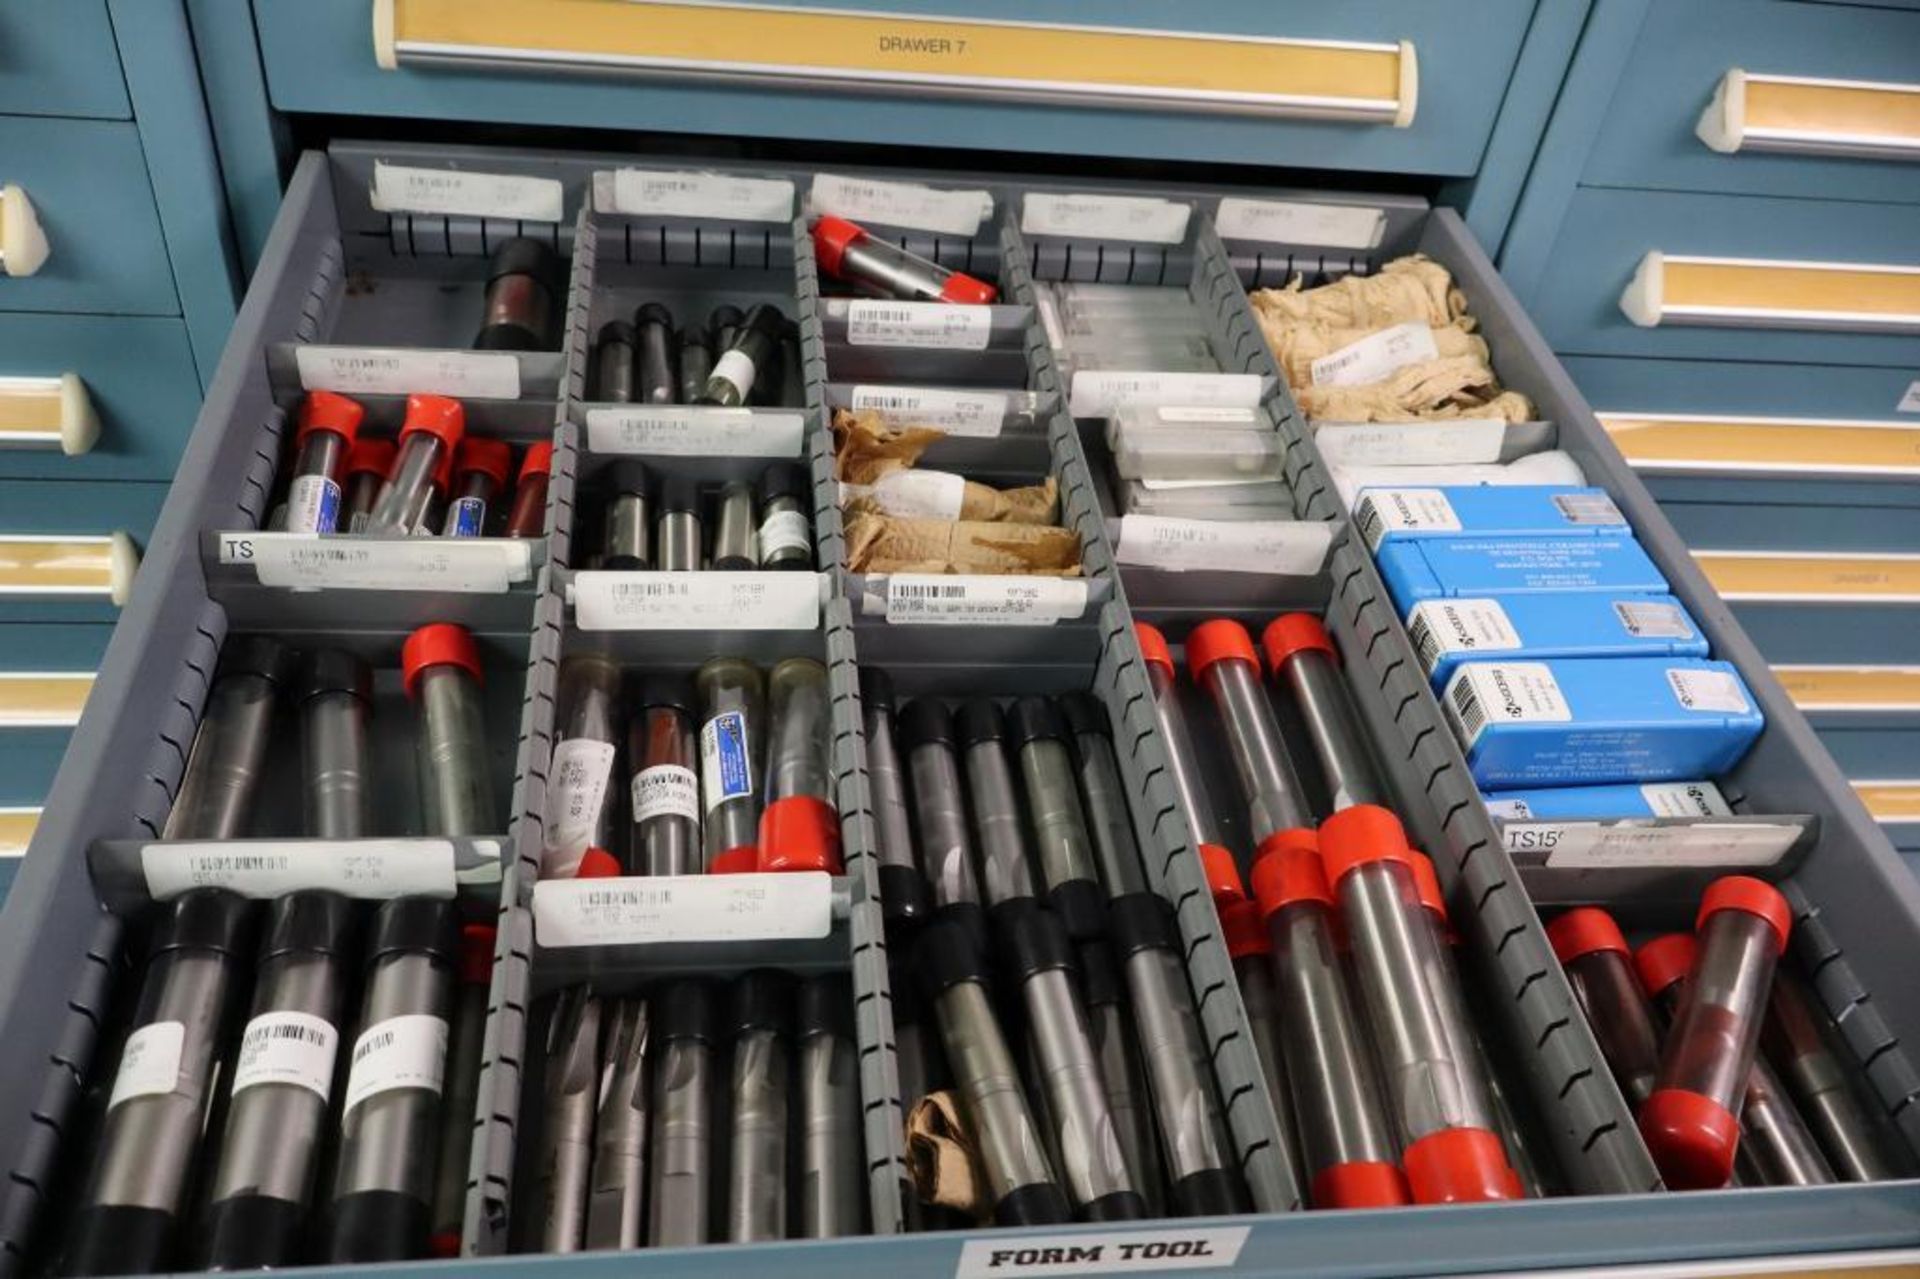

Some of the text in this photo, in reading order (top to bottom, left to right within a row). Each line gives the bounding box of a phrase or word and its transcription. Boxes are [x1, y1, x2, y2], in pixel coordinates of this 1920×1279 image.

[879, 36, 967, 54] DRAWER 7
[226, 540, 253, 559] TS
[1508, 830, 1564, 848] TS15
[988, 1240, 1214, 1268] FORM TOOL
